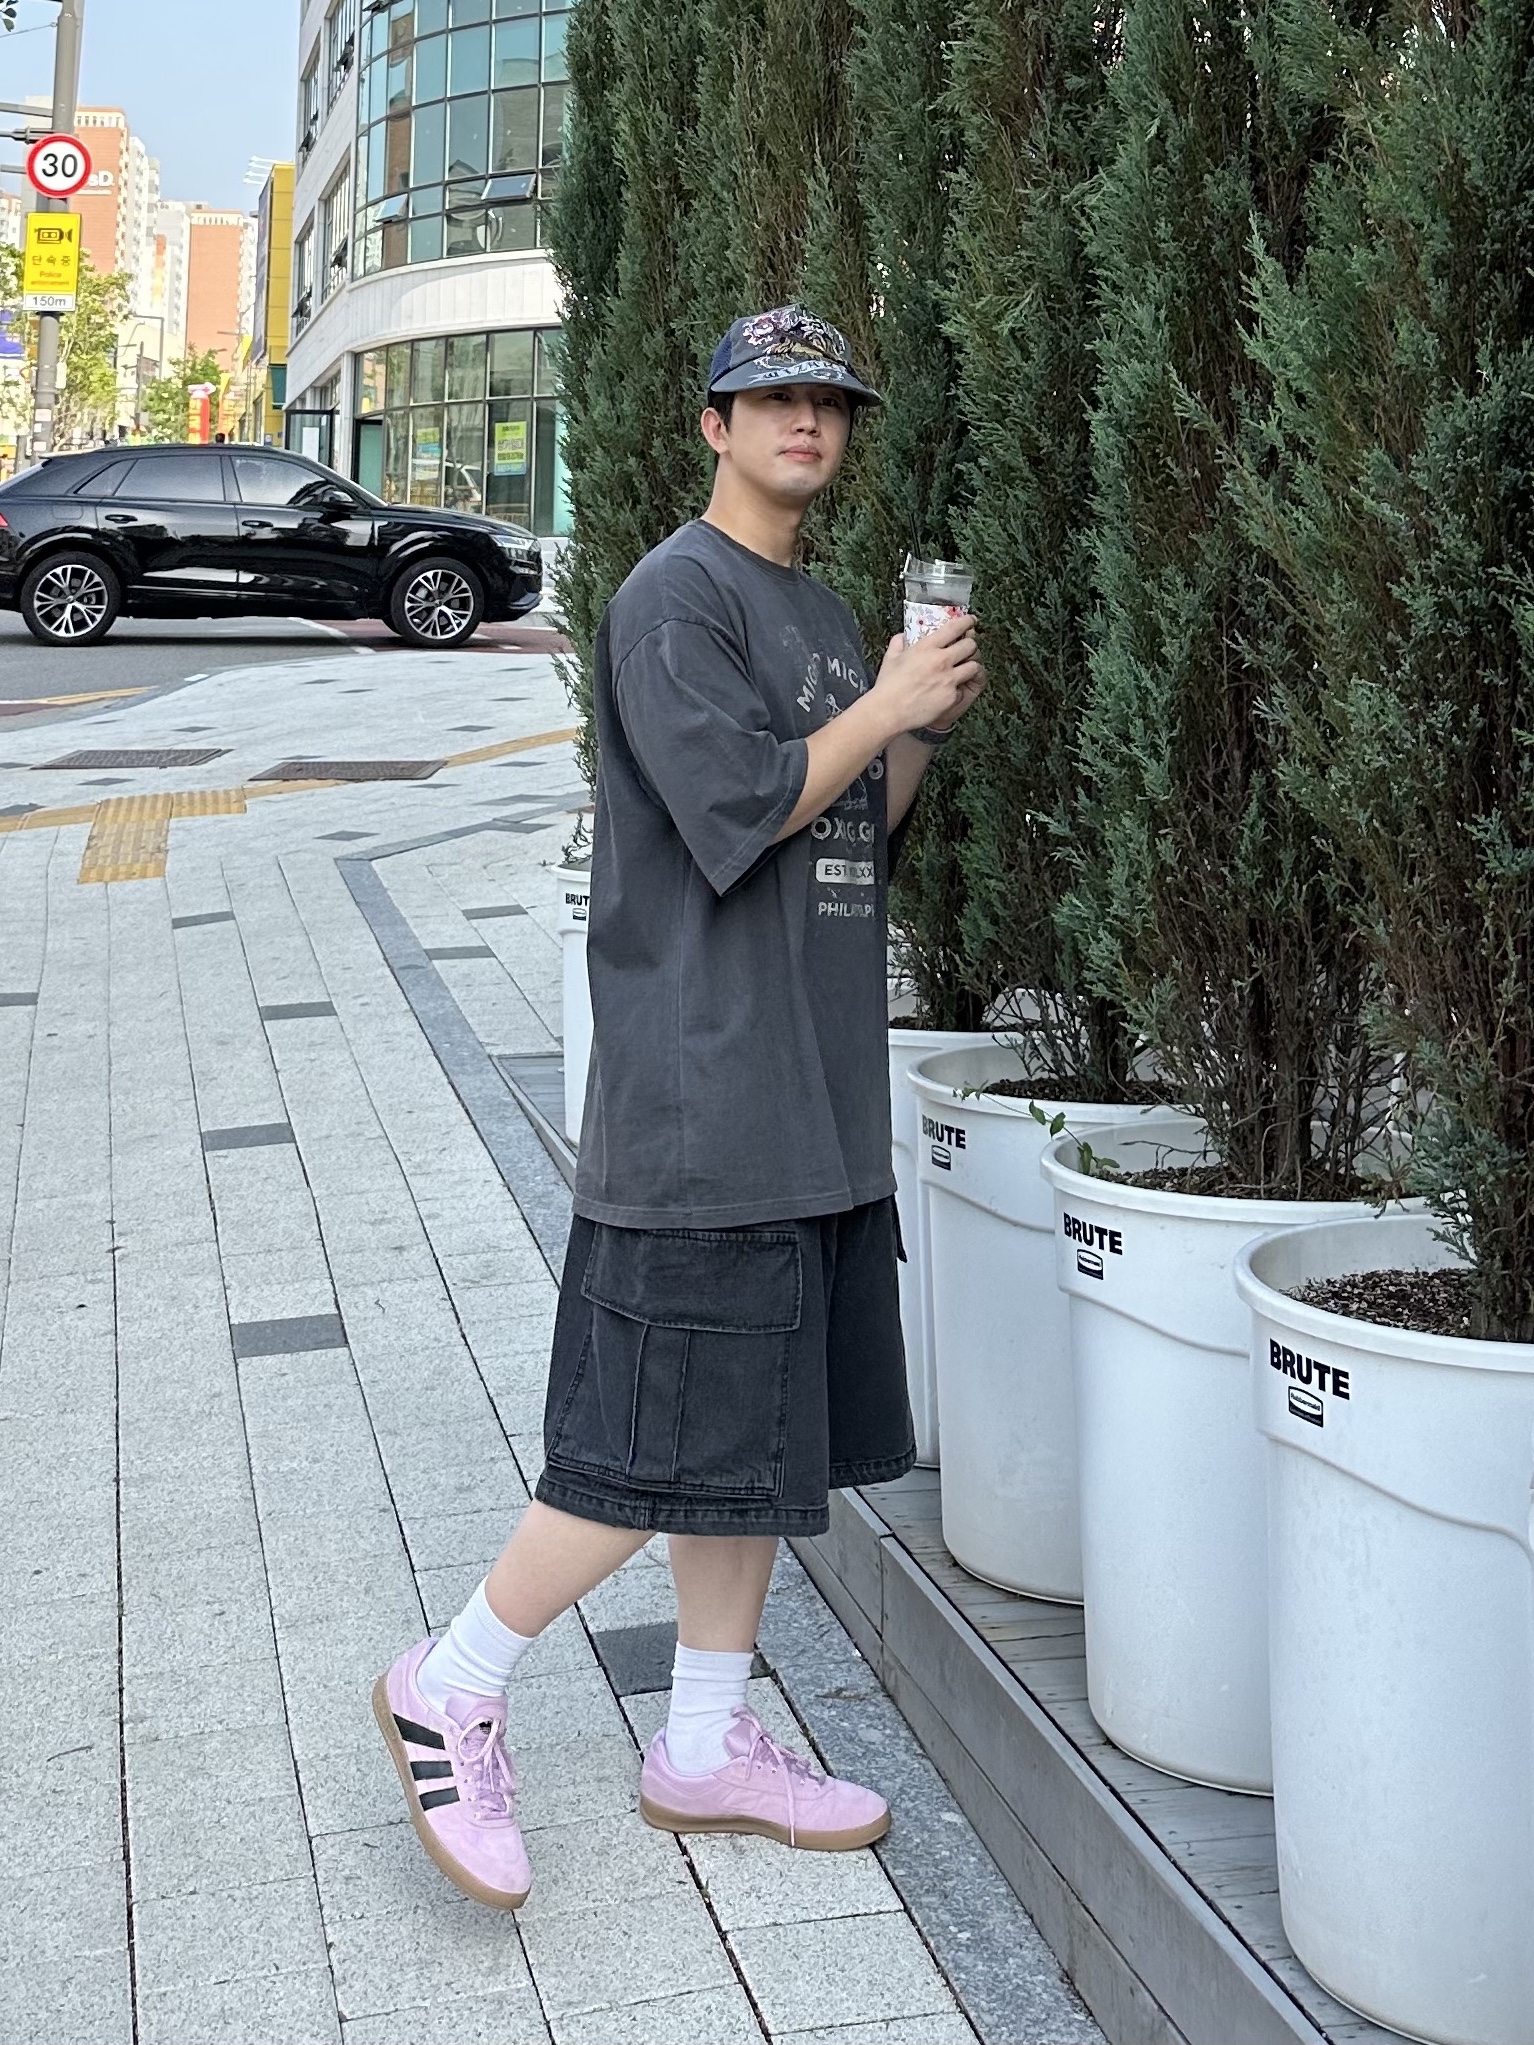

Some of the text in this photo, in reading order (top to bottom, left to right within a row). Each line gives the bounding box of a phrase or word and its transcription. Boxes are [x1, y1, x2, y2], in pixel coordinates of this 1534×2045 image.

[41, 153, 79, 178] 30
[33, 296, 66, 306] 150m
[565, 892, 590, 906] BRUT
[922, 1114, 966, 1149] BRUTE
[1063, 1211, 1123, 1255] BRUTE
[1269, 1337, 1350, 1401] BRUTE
